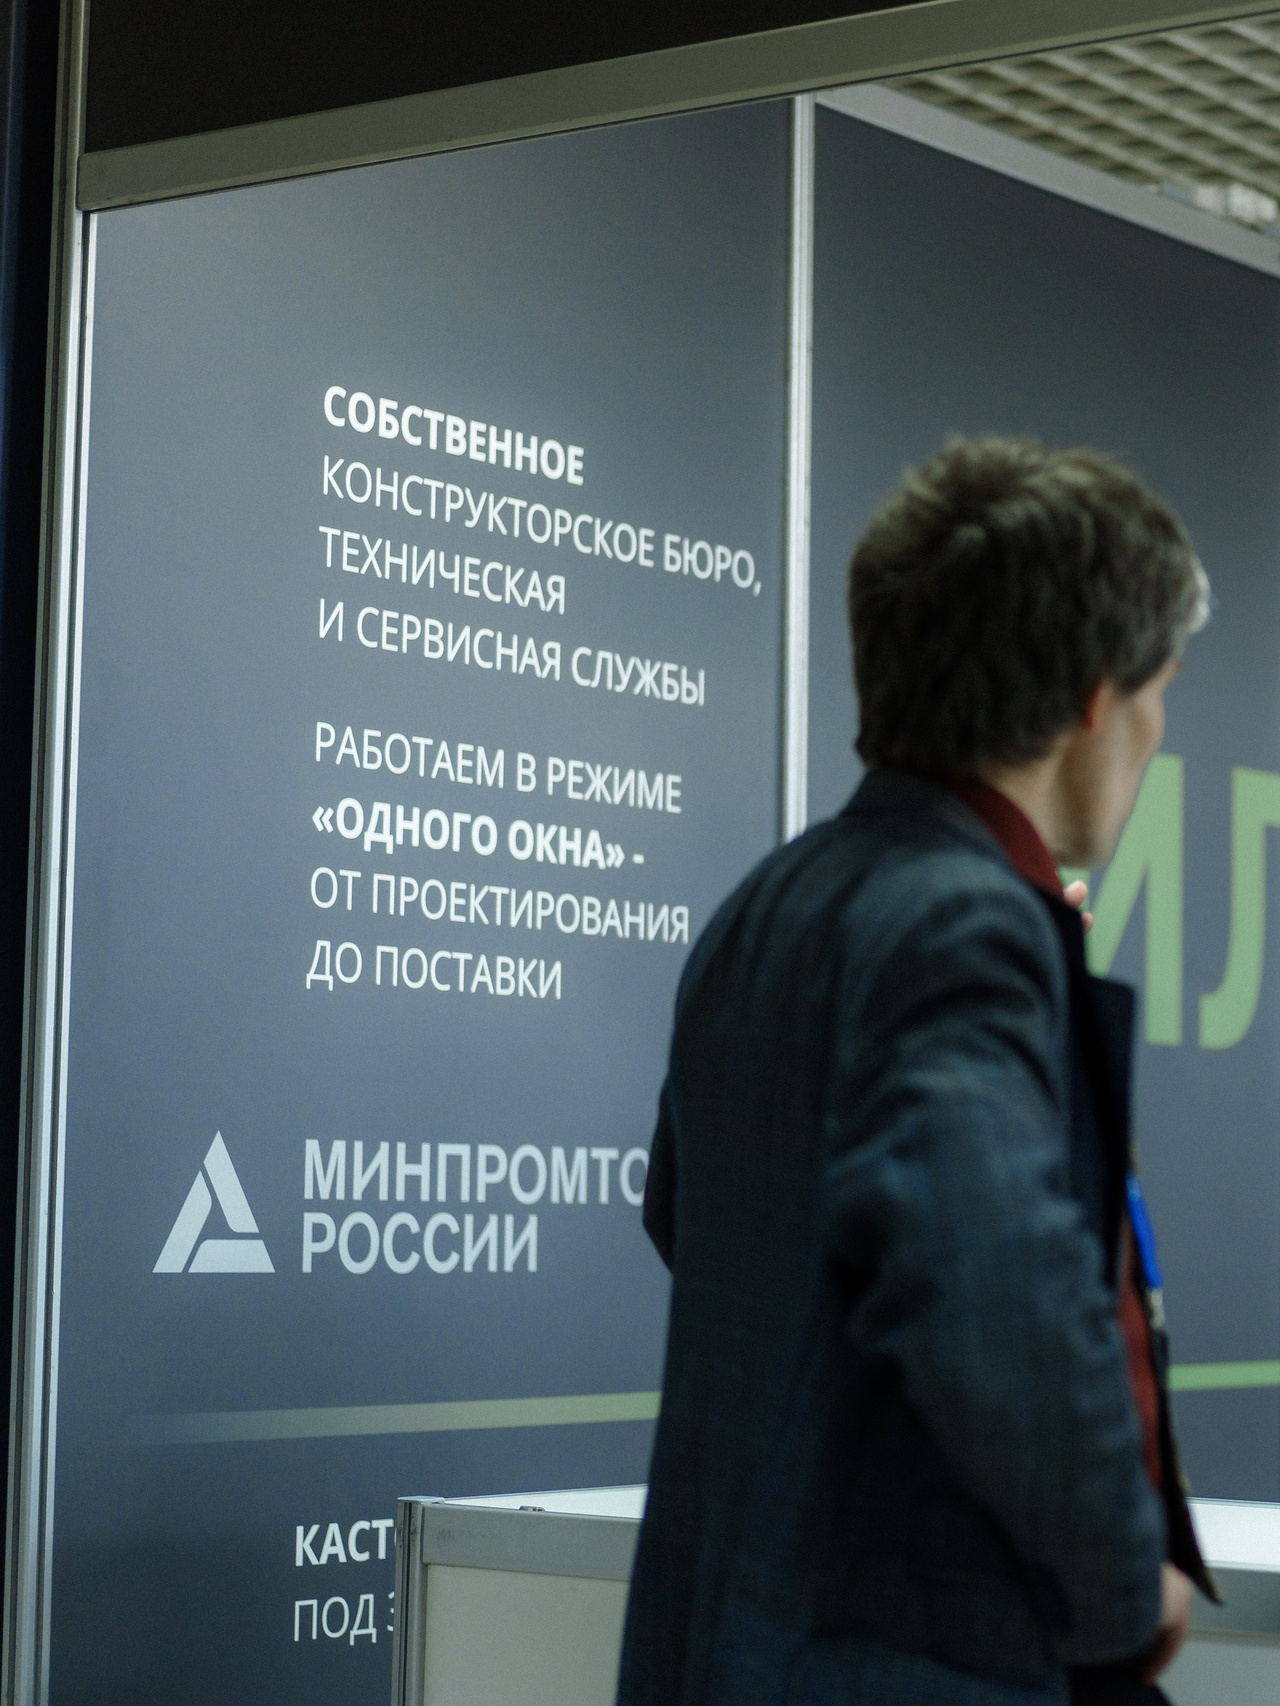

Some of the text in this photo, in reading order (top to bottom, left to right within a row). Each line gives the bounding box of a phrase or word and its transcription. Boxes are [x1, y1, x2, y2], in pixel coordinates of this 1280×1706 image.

[322, 385, 585, 486] СОБСТВЕННОЕ
[322, 455, 762, 597] КОНСТРУКТОРСКОЕ БЮРО,
[318, 525, 566, 615] ТЕХНИЧЕСКАЯ
[318, 598, 706, 707] И СЕРВИСНАЯ СЛУЖБЫ
[315, 721, 683, 814] РАБОТАЕМ В РЕЖИМЕ
[311, 797, 498, 856] «ОДНОГО
[507, 820, 625, 870] ОКНА»
[310, 866, 690, 945] ОТ ПРОЕКТИРОВАНИЯ
[306, 939, 562, 1000] ДО ПОСТАВКИ
[301, 1211, 538, 1275] РОССИИ
[295, 1518, 397, 1567] КАСТ
[294, 1593, 377, 1646] ПОД
